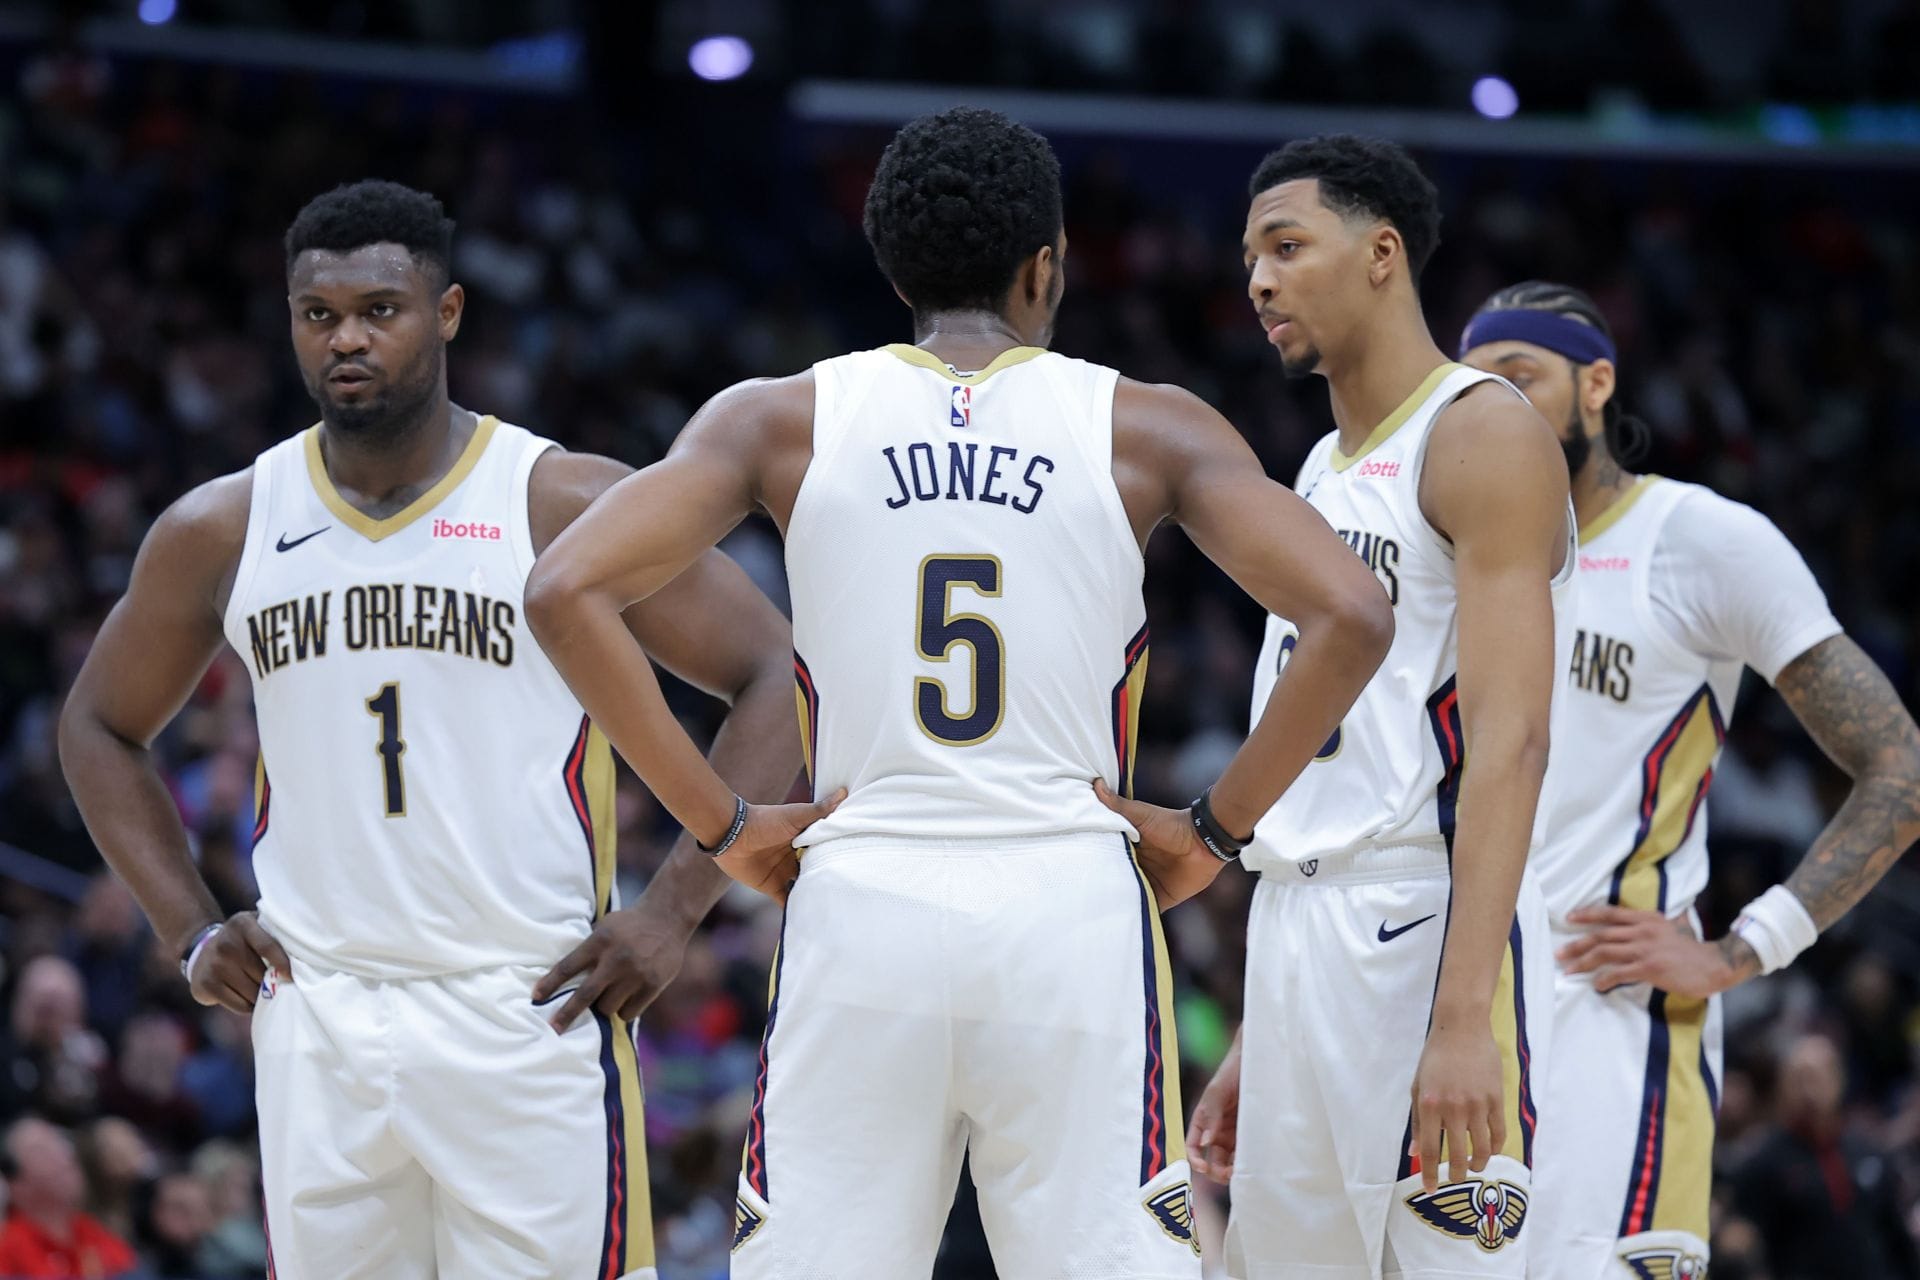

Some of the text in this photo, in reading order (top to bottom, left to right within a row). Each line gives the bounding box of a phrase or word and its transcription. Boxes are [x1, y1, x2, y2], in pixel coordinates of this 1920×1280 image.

[882, 442, 1055, 514] JONES
[433, 519, 501, 539] ibotta
[247, 583, 516, 681] NEW ORLEANS
[913, 553, 1006, 747] 5
[1568, 628, 1635, 703] ANS
[364, 680, 407, 819] 1
